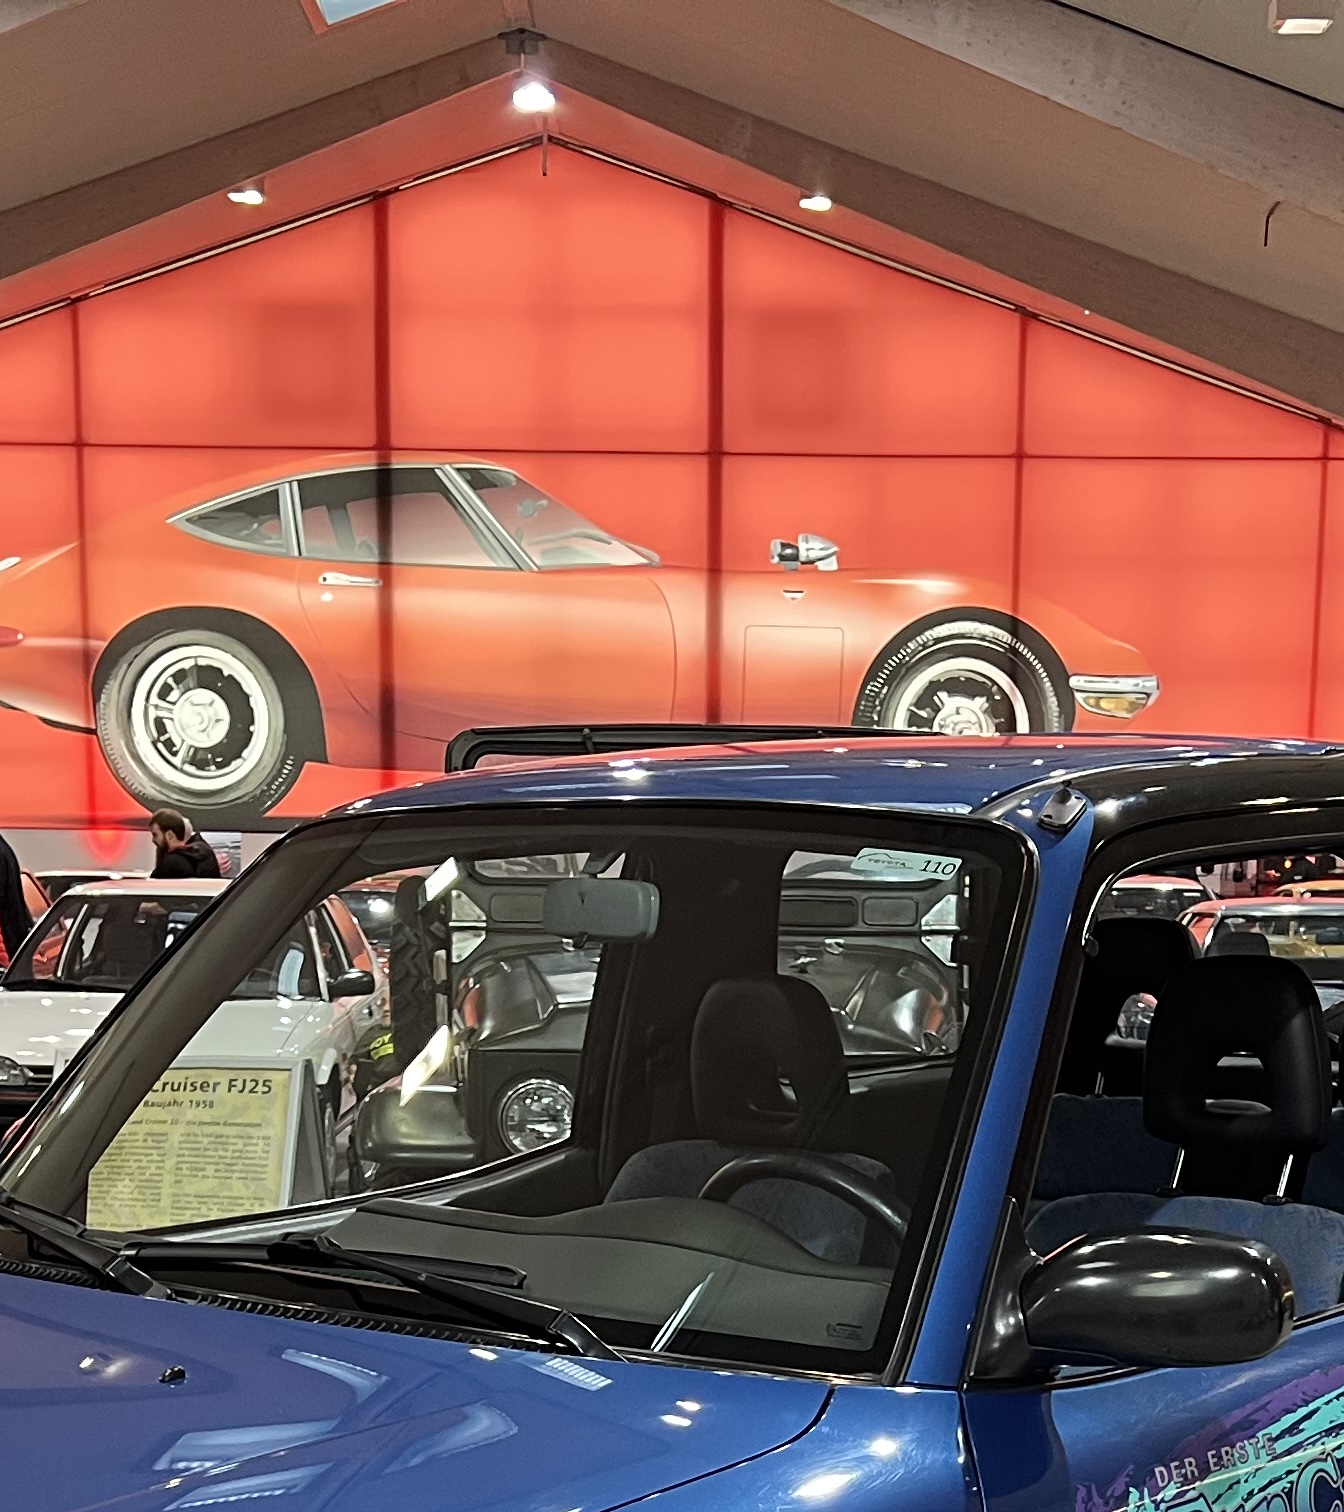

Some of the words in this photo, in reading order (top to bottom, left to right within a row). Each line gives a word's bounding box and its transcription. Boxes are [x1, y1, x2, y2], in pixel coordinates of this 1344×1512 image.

[919, 860, 956, 875] 110
[227, 1078, 273, 1095] FJ25
[143, 1099, 184, 1110] Baujahr
[188, 1099, 215, 1110] 1958
[1155, 1459, 1199, 1488] DER
[1208, 1433, 1278, 1473] ERSTE
